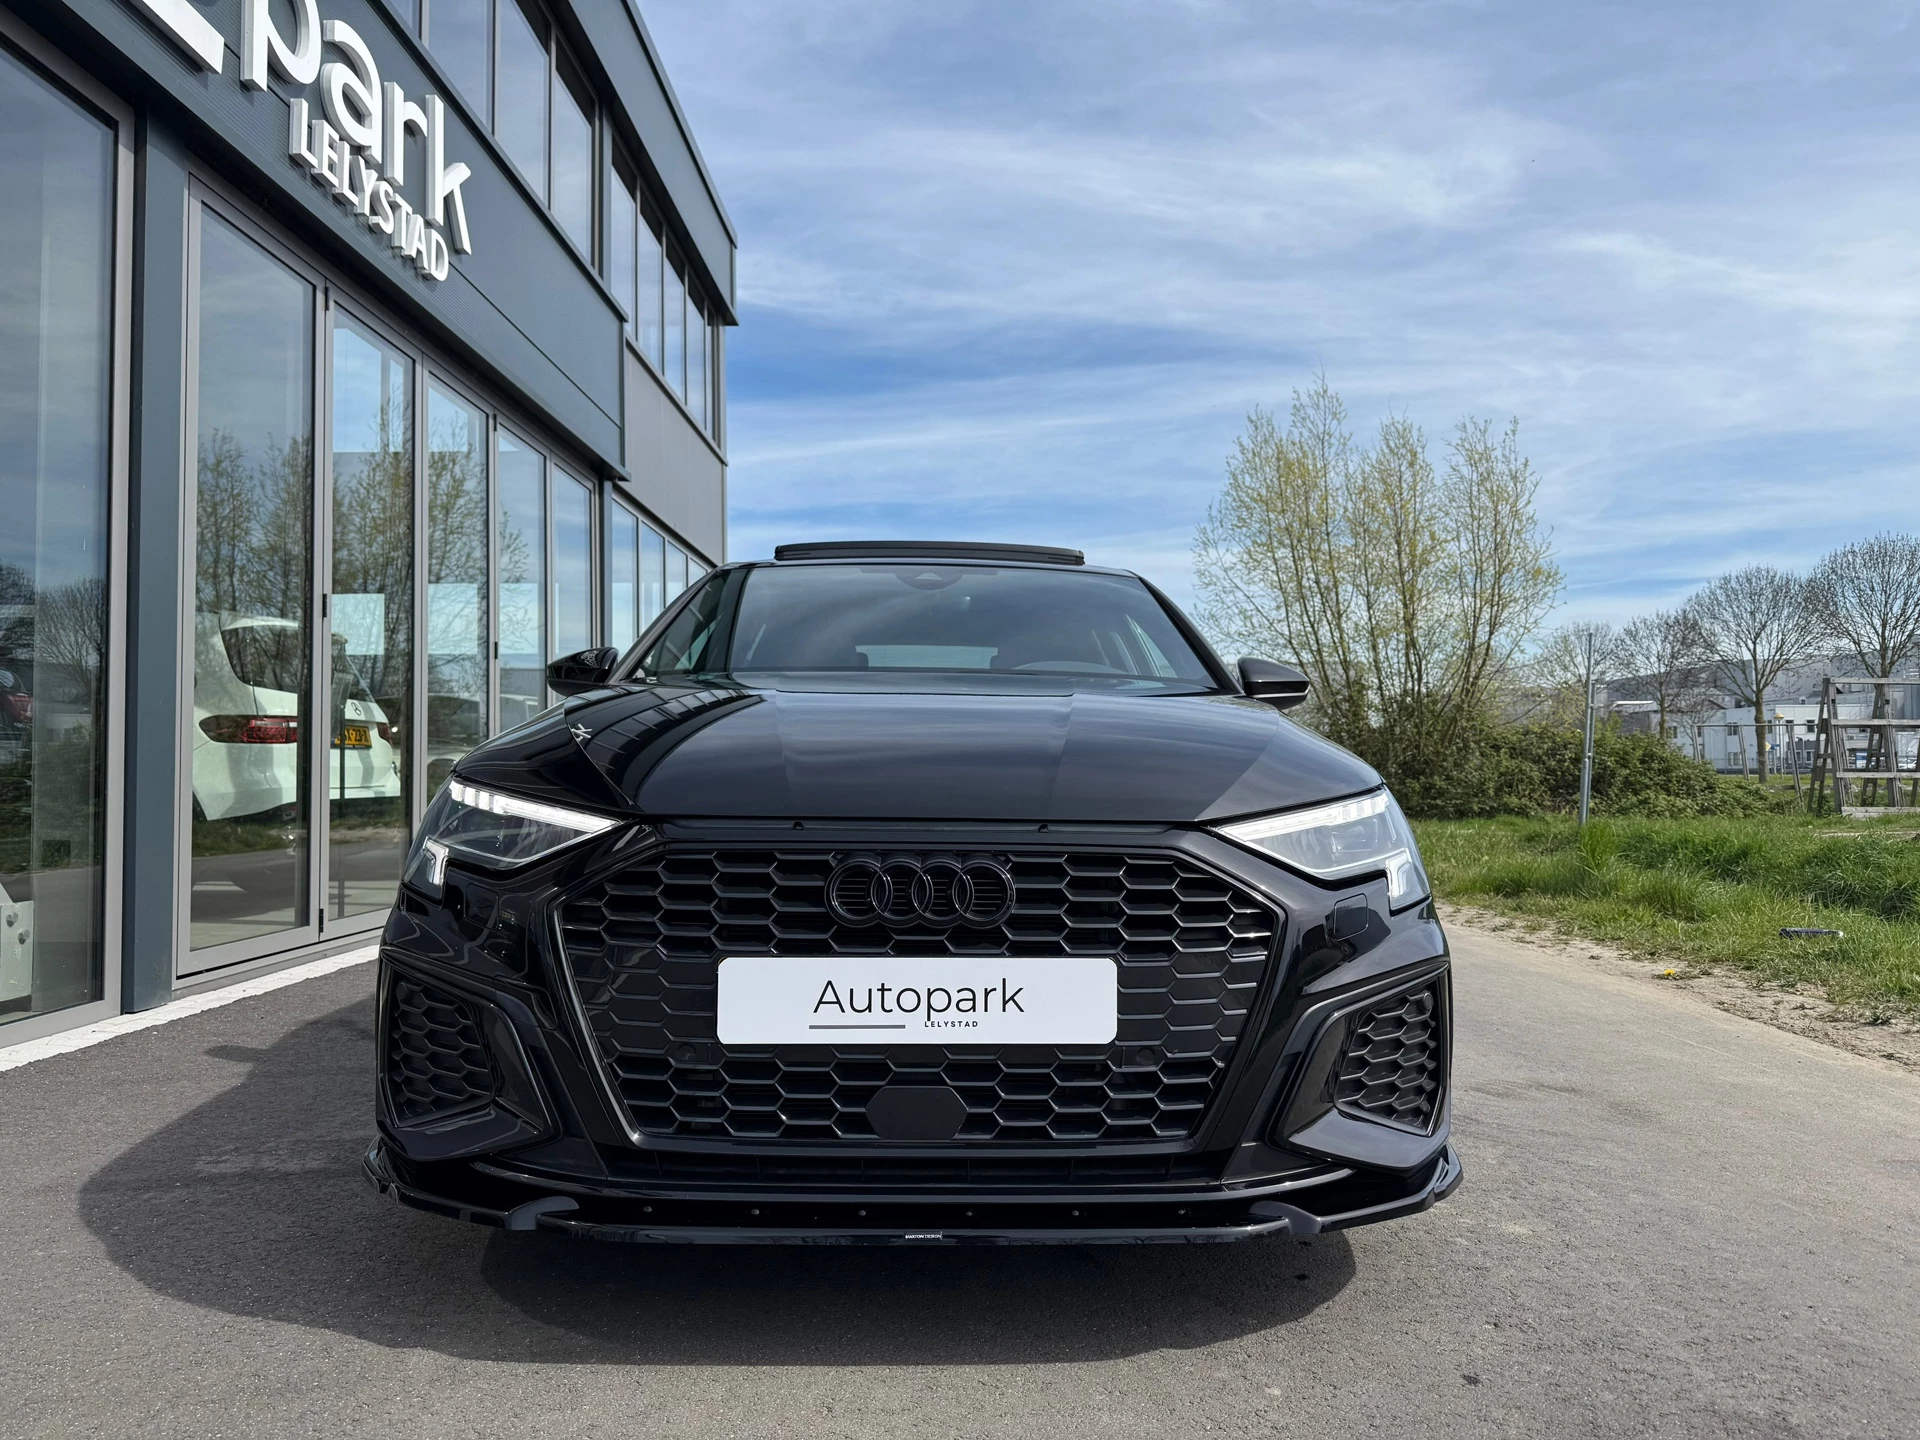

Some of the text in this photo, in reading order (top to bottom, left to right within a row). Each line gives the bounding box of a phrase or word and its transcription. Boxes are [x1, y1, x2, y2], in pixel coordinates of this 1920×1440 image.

[289, 98, 449, 282] LELYSTAD
[813, 978, 1025, 1022] Autopark
[924, 1020, 979, 1028] LELYSTAD
